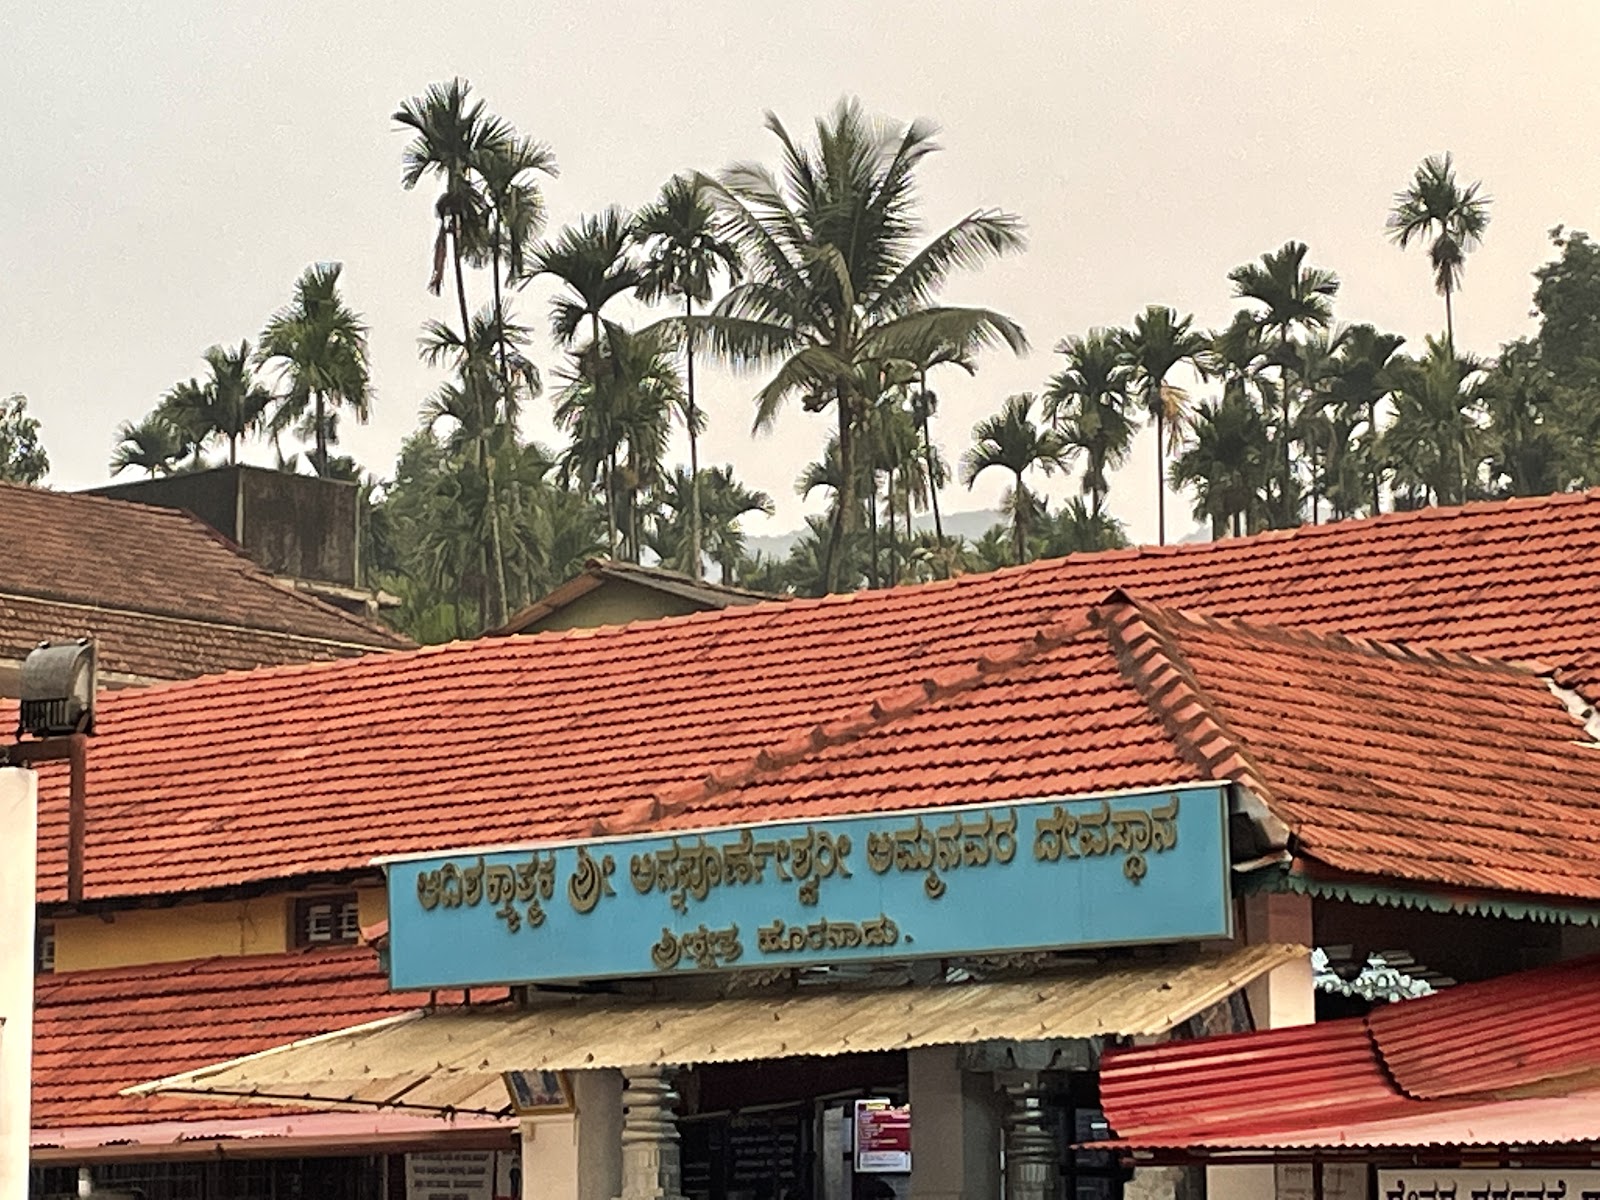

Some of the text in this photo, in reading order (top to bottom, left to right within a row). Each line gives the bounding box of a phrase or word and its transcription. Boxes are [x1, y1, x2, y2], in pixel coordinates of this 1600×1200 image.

[568, 845, 616, 914] ಶ್ರೀ
[867, 807, 1018, 899] ಅಮ್ಮನವರ
[1034, 794, 1180, 886] ದೇವಸ್ಥಾನ
